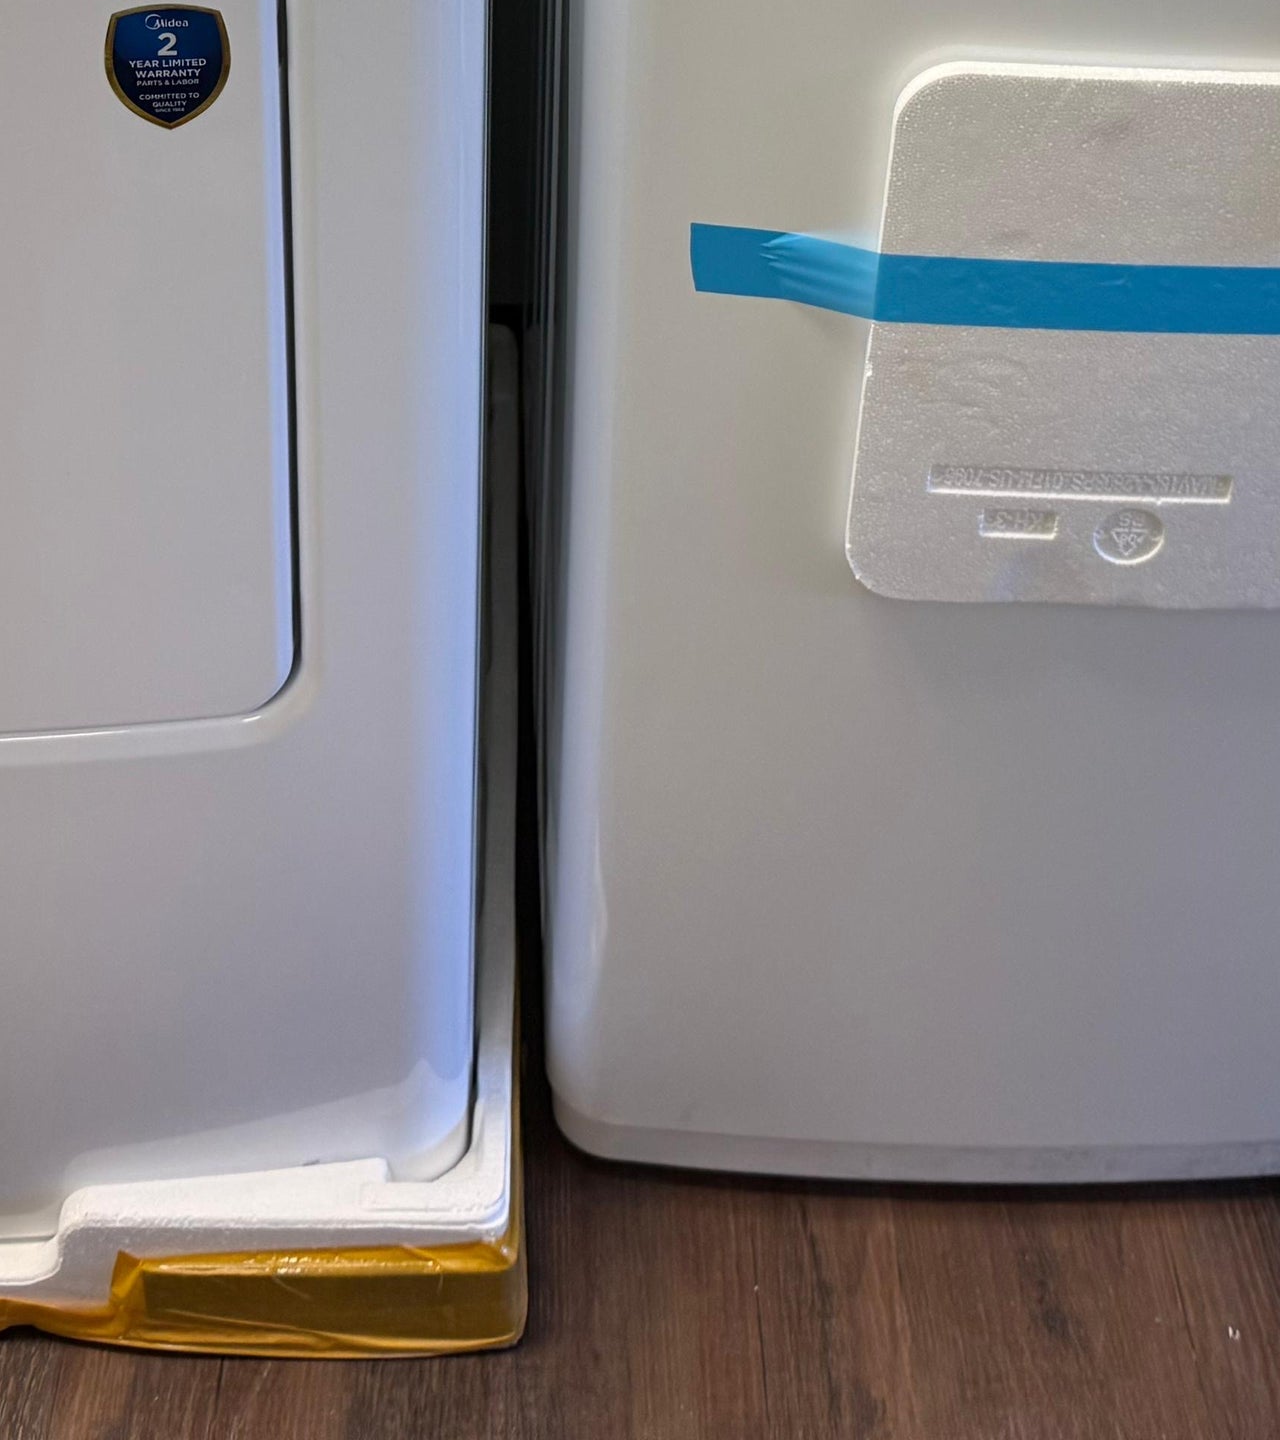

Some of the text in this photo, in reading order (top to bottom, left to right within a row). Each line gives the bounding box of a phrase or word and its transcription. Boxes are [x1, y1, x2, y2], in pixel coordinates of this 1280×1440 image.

[145, 14, 189, 30] Midea
[157, 32, 178, 57] 2
[129, 58, 206, 68] YEAR LIMITED
[136, 69, 201, 78] WARRANTY
[136, 78, 163, 86] PARTS
[172, 78, 199, 86] LABOR
[139, 92, 186, 101] COMMITTED
